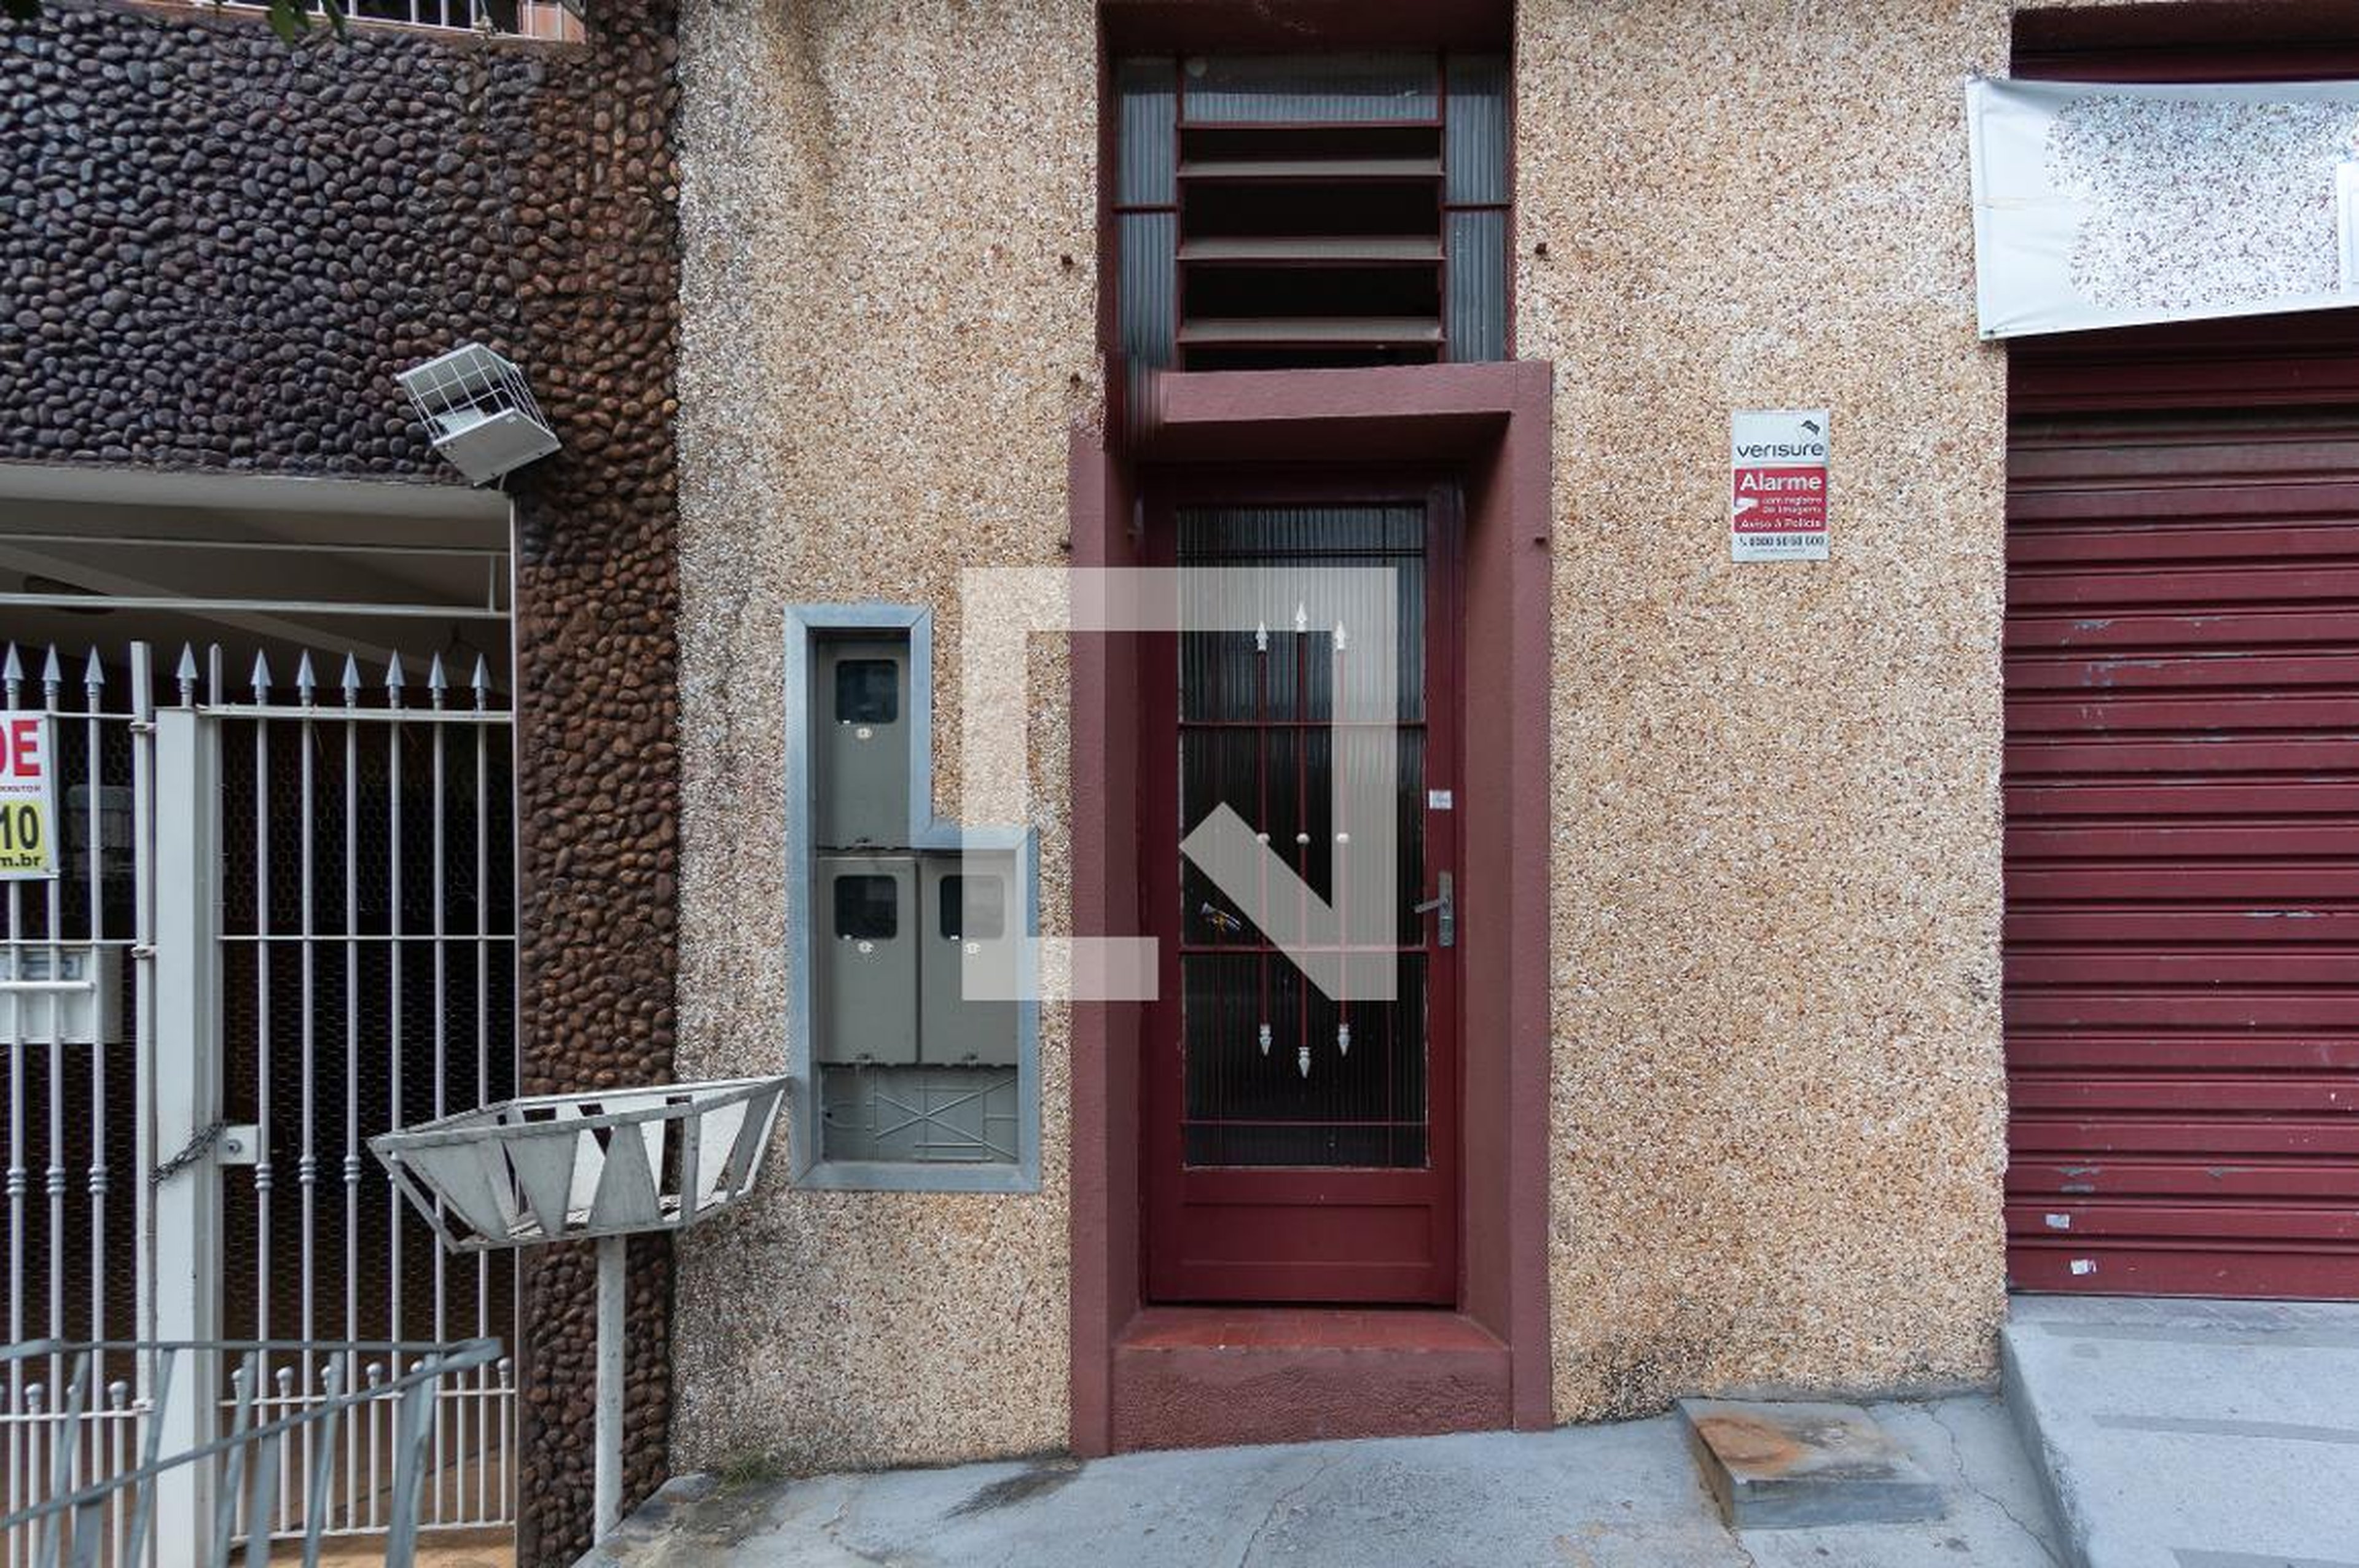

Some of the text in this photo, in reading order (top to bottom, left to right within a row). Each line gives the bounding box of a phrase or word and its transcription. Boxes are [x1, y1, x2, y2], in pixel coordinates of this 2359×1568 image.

[1737, 442, 1825, 458] verisure
[1740, 472, 1822, 491] Alarme
[0, 719, 41, 776] E
